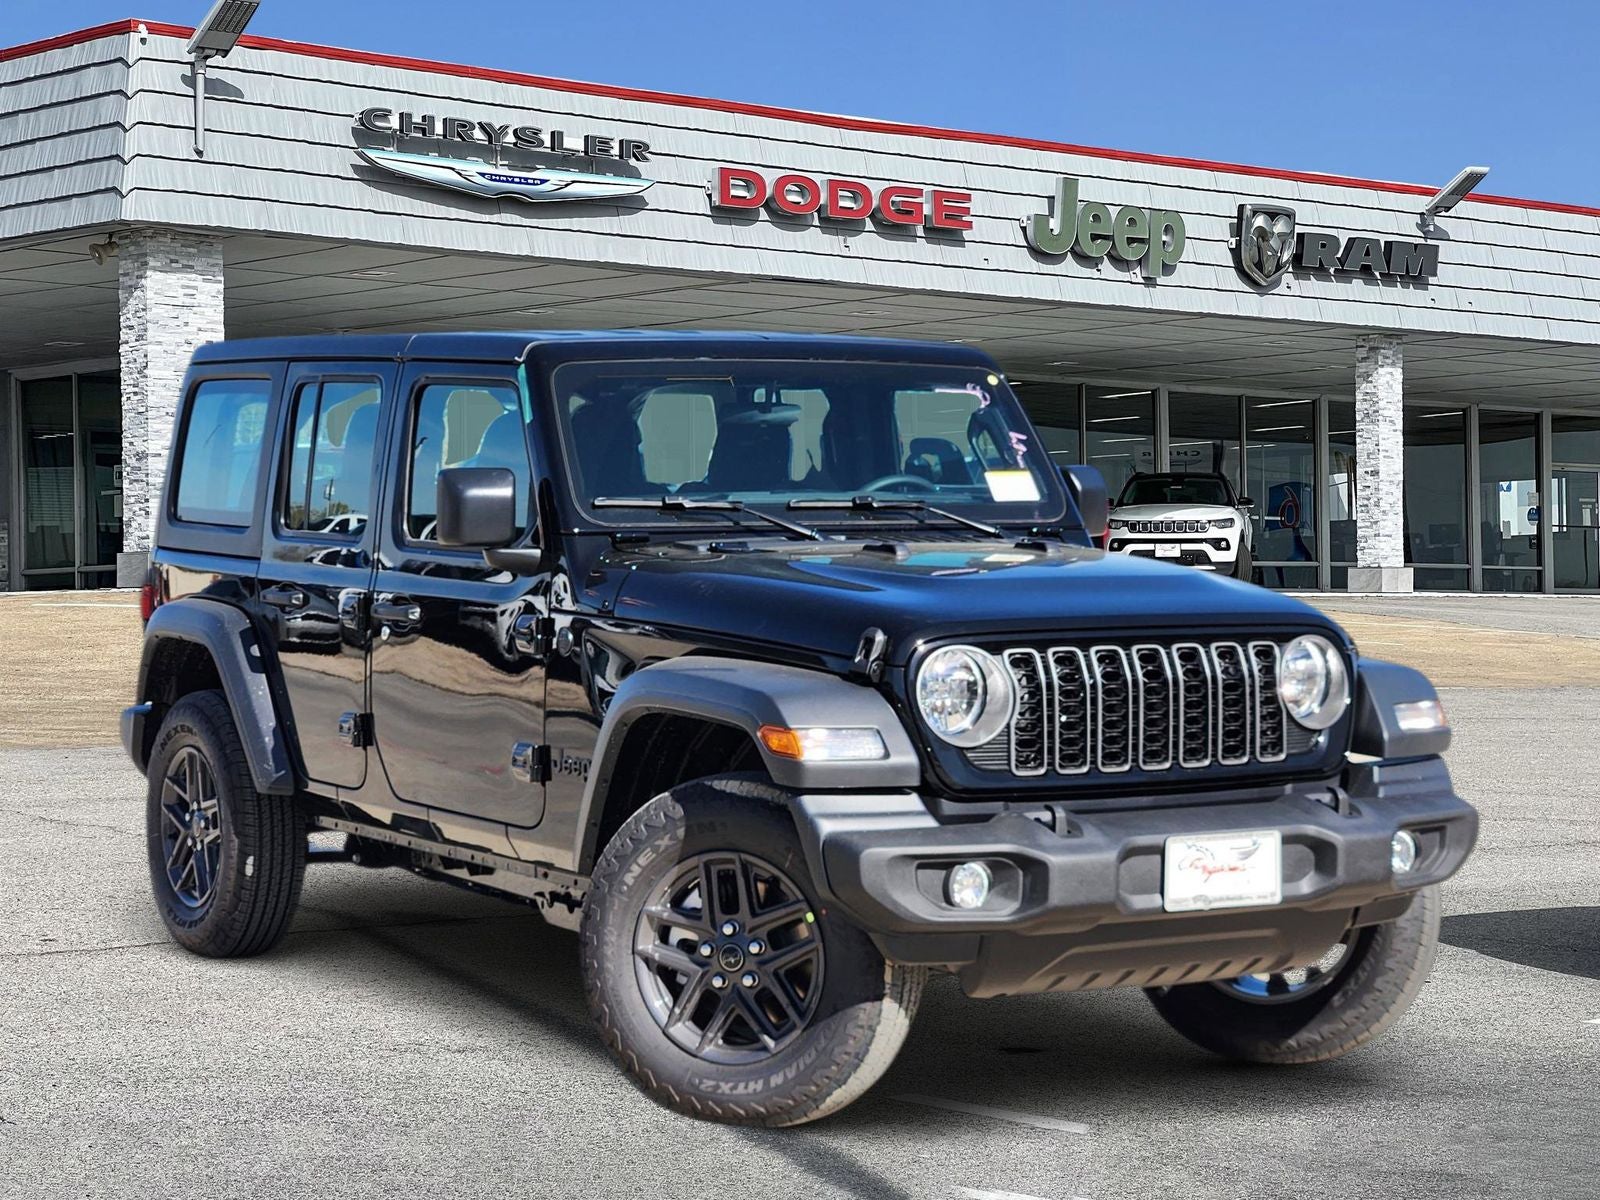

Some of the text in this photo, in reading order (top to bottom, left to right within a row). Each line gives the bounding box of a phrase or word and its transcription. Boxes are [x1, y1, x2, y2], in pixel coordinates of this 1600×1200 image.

[359, 107, 651, 162] CHRYSLER
[484, 174, 541, 185] CHRYSLER
[714, 167, 973, 231] DODGE
[1026, 177, 1187, 278] Jeep
[1297, 232, 1440, 278] RAM
[552, 748, 592, 782] Jeep
